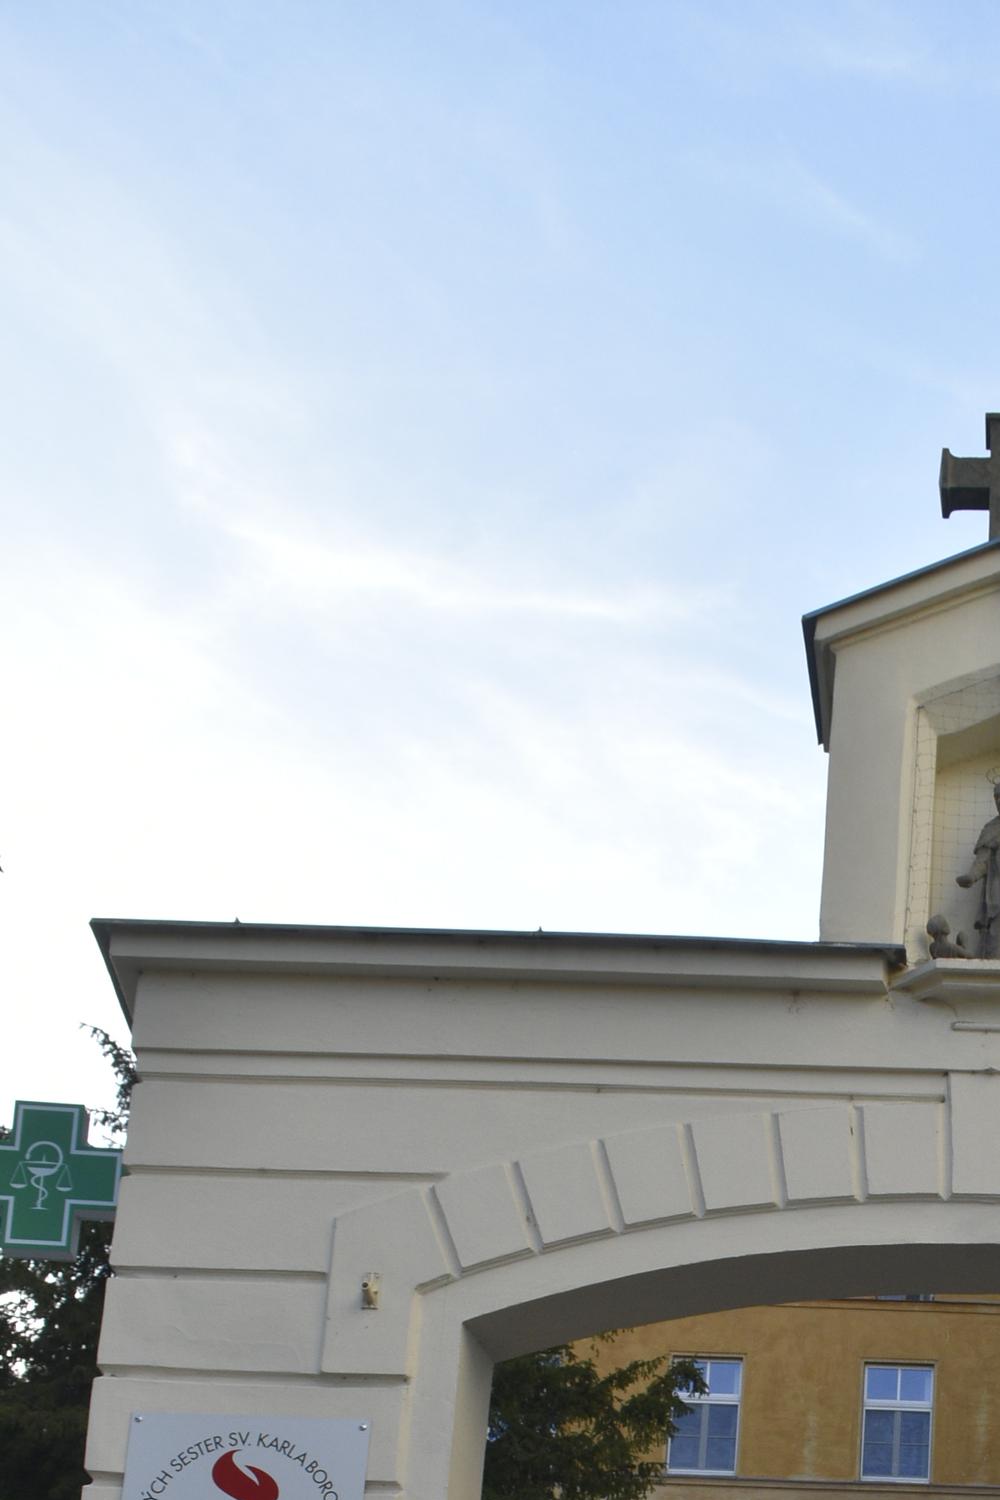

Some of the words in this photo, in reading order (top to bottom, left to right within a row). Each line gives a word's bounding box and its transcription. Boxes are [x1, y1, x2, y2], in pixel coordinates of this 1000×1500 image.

[170, 1435, 225, 1473] SESTER
[228, 1431, 252, 1447] SV.
[256, 1433, 308, 1467] KARLA
